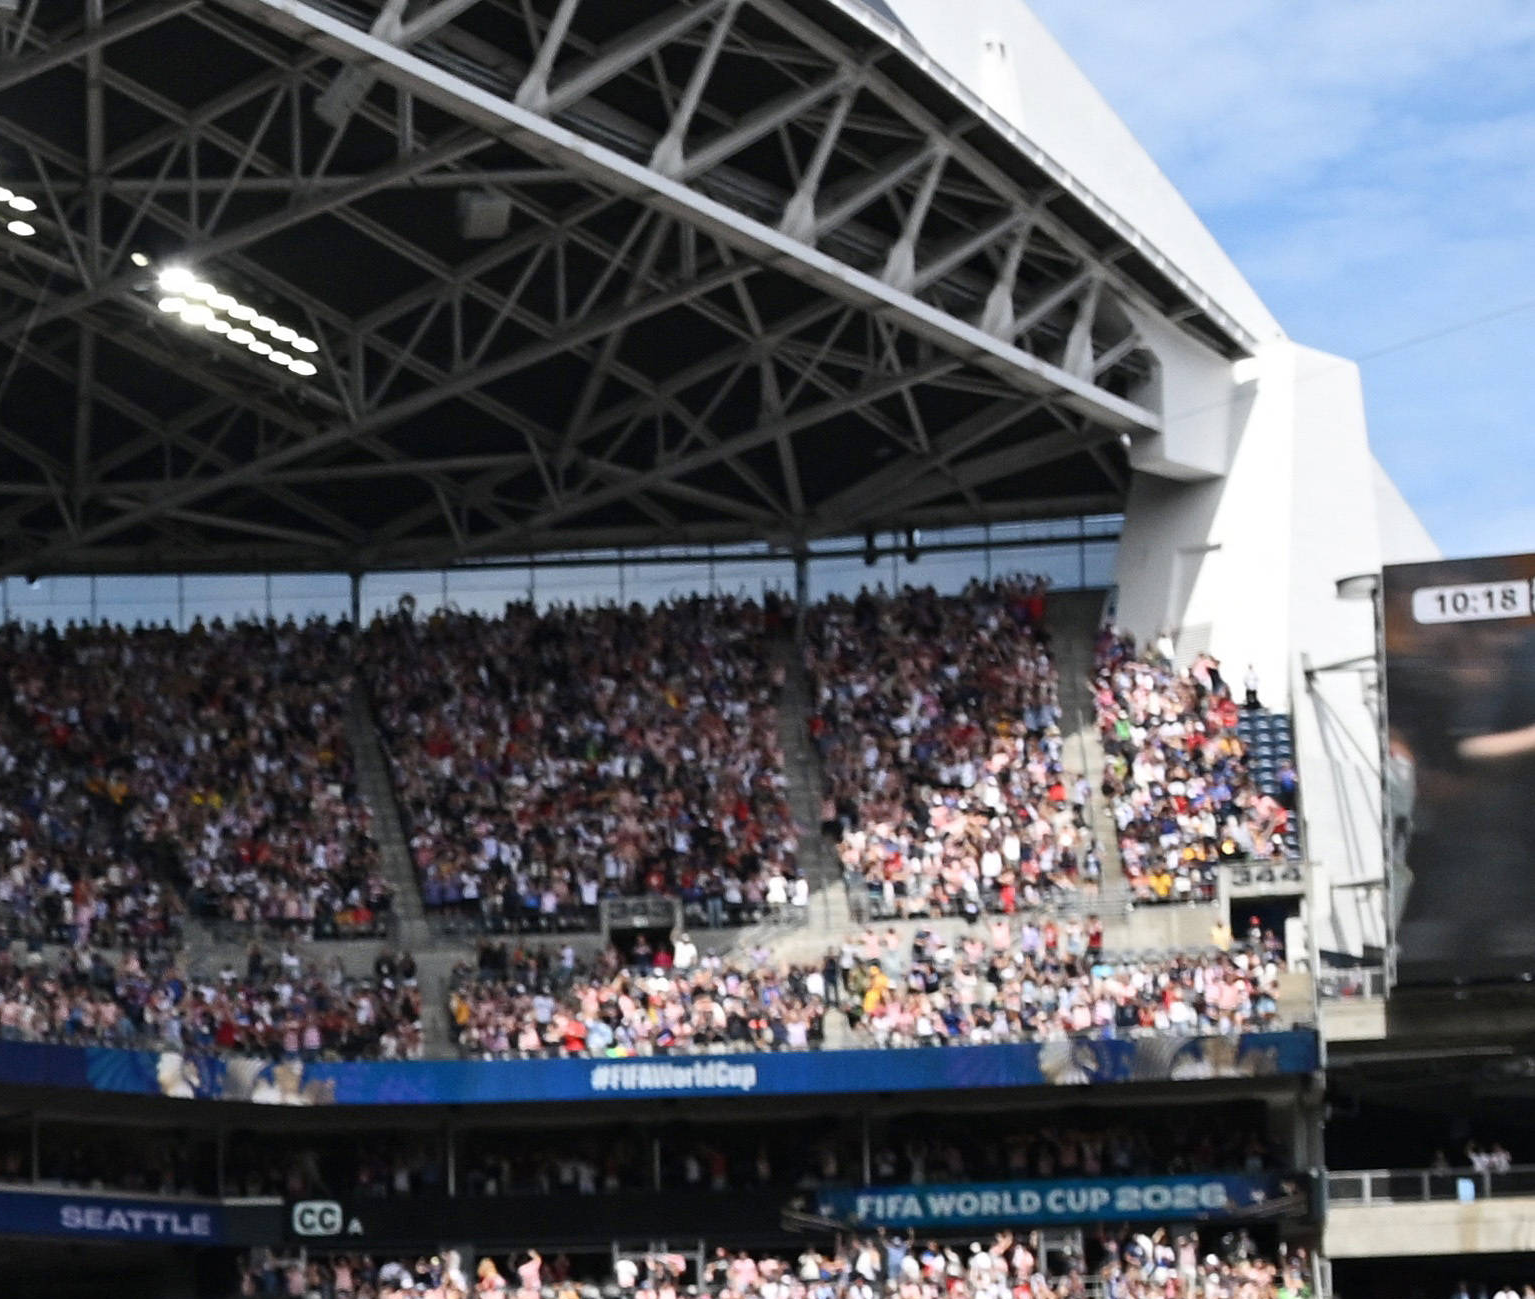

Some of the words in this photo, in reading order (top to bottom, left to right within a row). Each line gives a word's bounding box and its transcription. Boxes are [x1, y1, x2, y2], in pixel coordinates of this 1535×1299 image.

[1436, 587, 1518, 616] 10:18
[590, 1061, 758, 1092] #FIFAWorldCup
[855, 1193, 924, 1221] FIFA
[927, 1189, 1044, 1218] WORLD
[1046, 1184, 1111, 1214] CUP
[1114, 1181, 1228, 1212] 2026
[60, 1204, 211, 1237] SEATTLE
